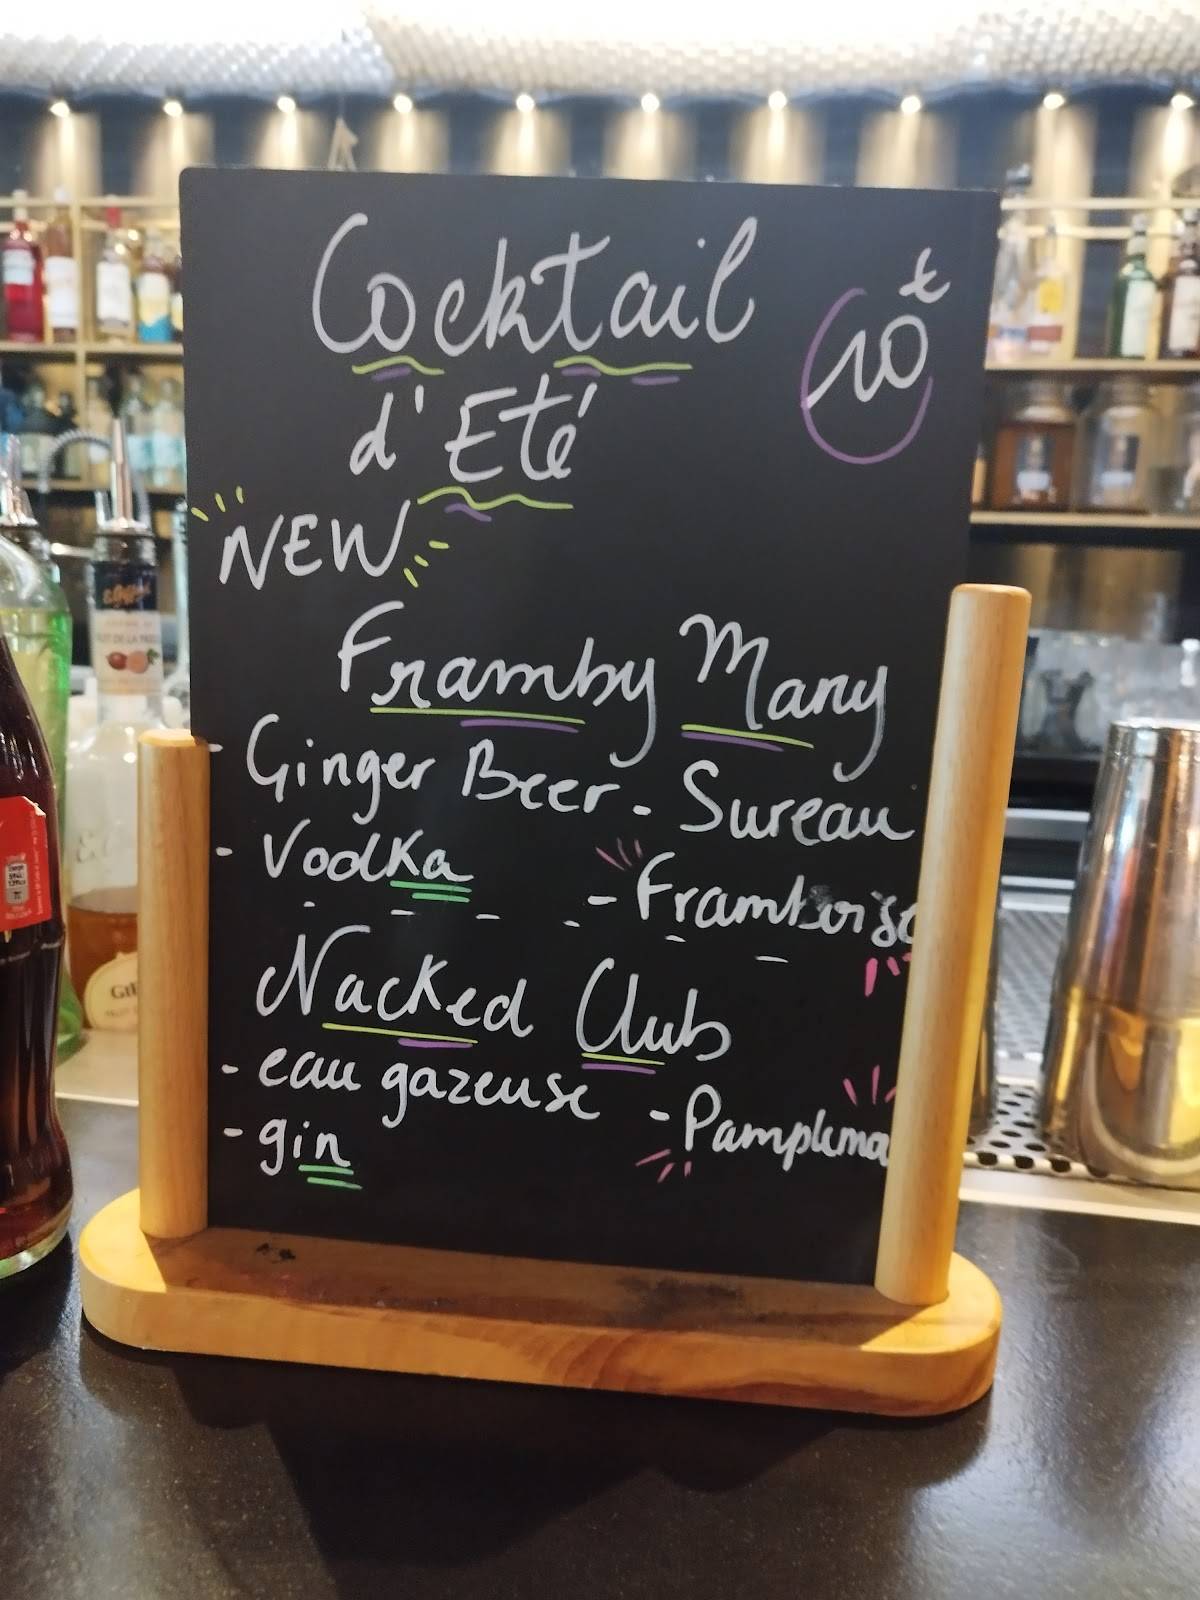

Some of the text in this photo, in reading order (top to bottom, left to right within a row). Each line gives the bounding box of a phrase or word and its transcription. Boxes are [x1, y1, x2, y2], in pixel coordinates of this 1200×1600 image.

[312, 212, 758, 357] Cocktail
[802, 313, 929, 410] 10
[218, 499, 412, 590] NEW
[246, 712, 621, 826] Ginger Beer
[679, 759, 916, 847] Sureau
[263, 818, 475, 883] Vodka
[256, 924, 732, 1062] Nacked Club
[258, 1047, 601, 1129] eau gazeuse
[258, 1118, 351, 1177] gin
